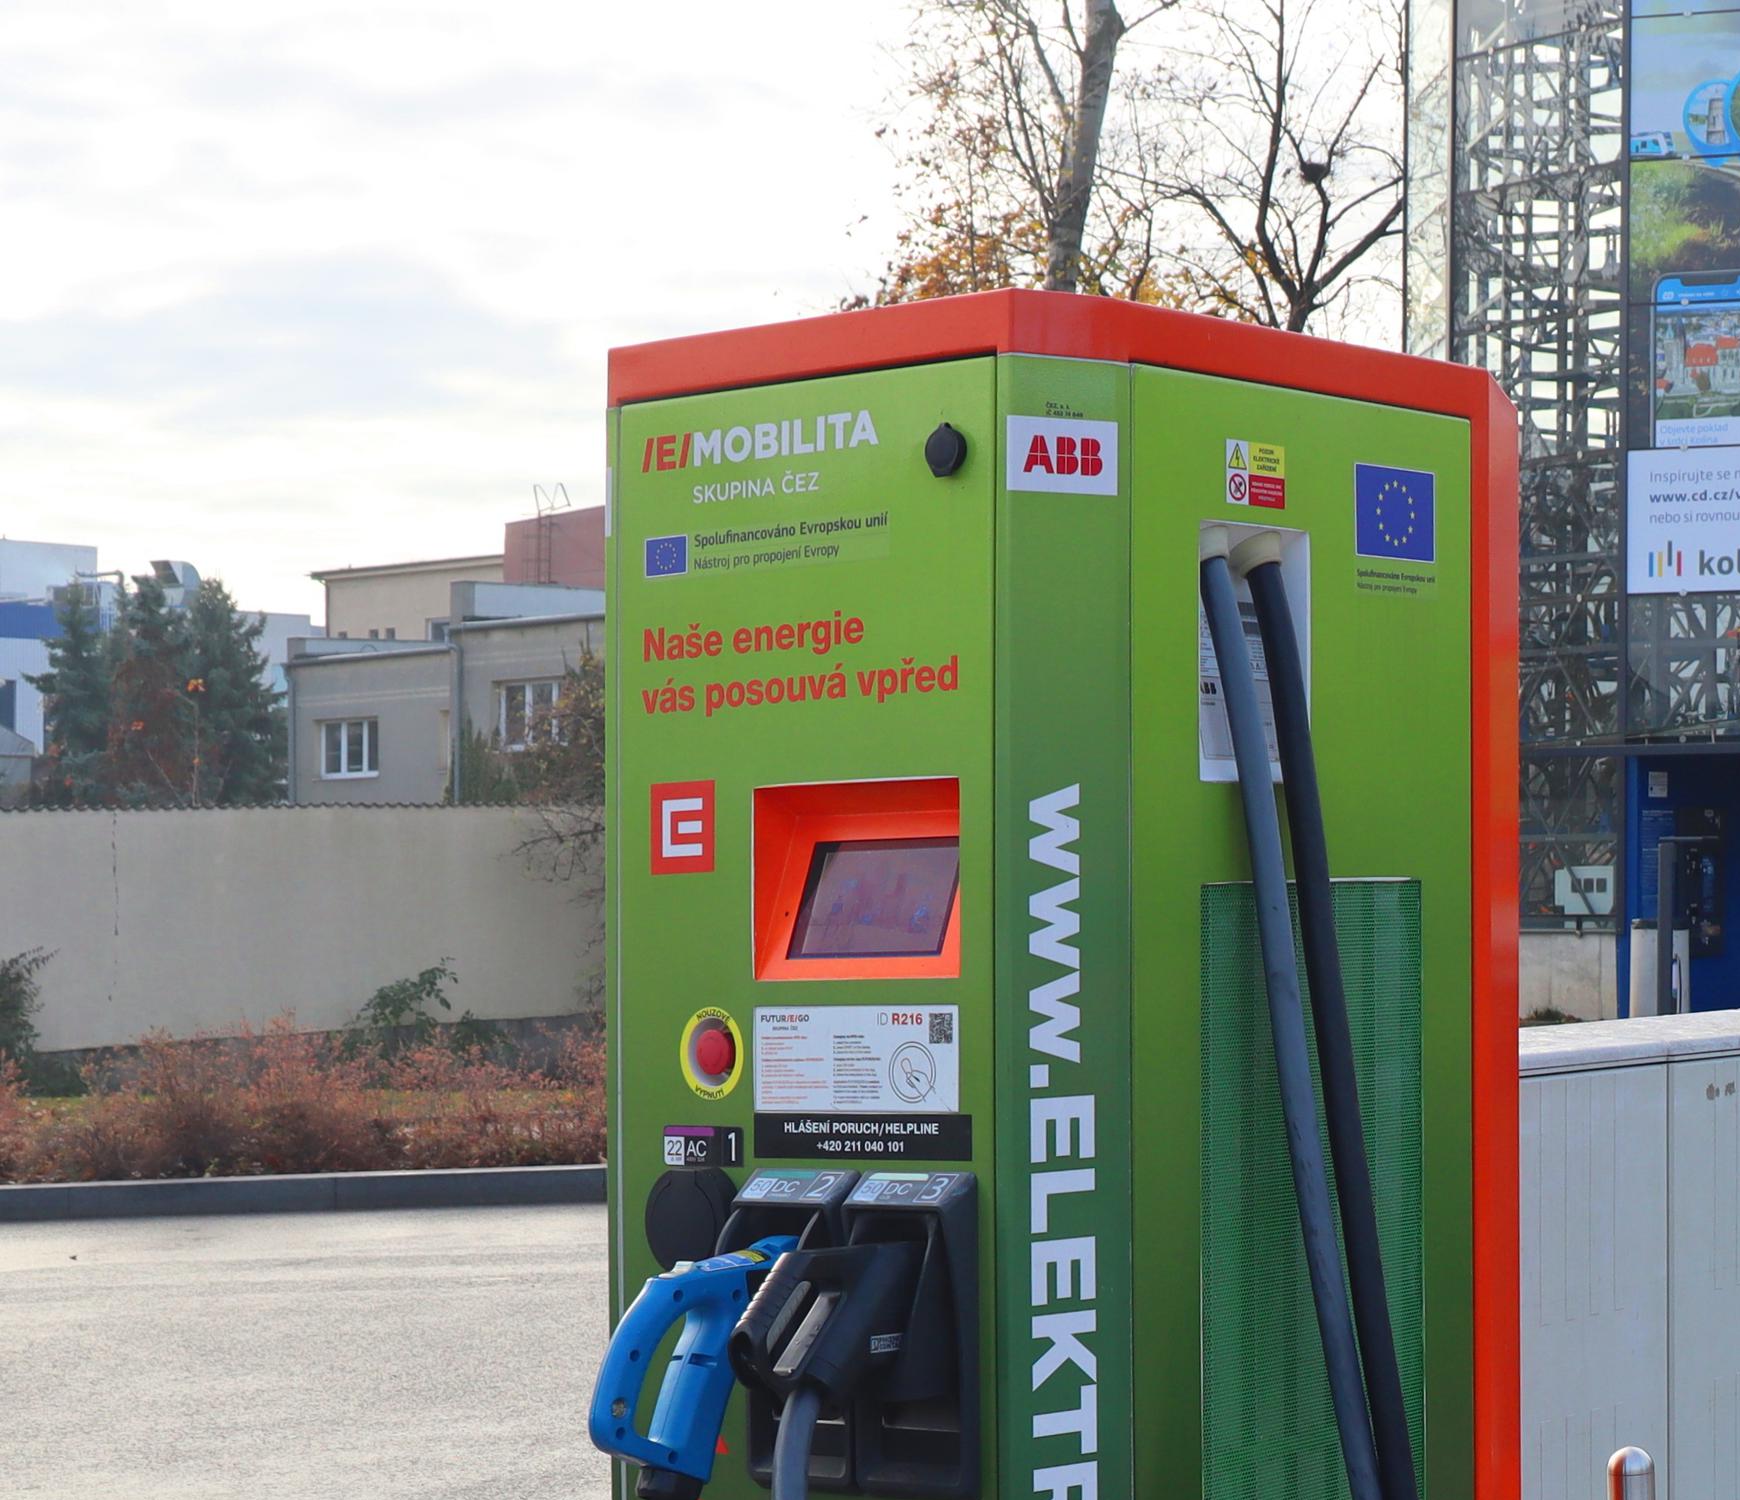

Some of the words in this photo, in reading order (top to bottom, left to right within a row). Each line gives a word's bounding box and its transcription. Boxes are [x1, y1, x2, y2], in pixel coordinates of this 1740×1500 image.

[1023, 434, 1103, 476] ABB
[693, 477, 775, 504] SKUPINA
[782, 470, 819, 494] ČEZ
[1650, 470, 1713, 485] Inspirujte
[1717, 470, 1731, 480] se
[694, 524, 796, 548] Spolufinancováno
[800, 516, 861, 536] Evropskou
[865, 511, 889, 528] unií
[1650, 511, 1681, 524] nebo
[1684, 511, 1693, 523] si
[1696, 510, 1740, 522] rovnou
[694, 555, 730, 572] Nástroj
[733, 554, 750, 569] pro
[753, 546, 801, 567] propojení
[804, 544, 839, 558] Evropy
[643, 624, 722, 662] Naše
[733, 610, 864, 654] energie
[642, 678, 695, 714] vás
[705, 662, 847, 717] posouvá
[857, 655, 959, 703] vpřed
[877, 1012, 888, 1025] ID
[892, 1013, 923, 1026] R216
[784, 1119, 831, 1134] HLÁŠENÍ
[833, 1121, 939, 1137] PORUCH/HELPLINE
[667, 1140, 682, 1156] 22
[686, 1140, 707, 1157] AC
[728, 1132, 736, 1162] 1
[816, 1140, 842, 1152] +420
[845, 1141, 861, 1152] 211
[864, 1141, 883, 1152] 040
[888, 1141, 904, 1153] 101
[750, 1180, 770, 1192] 50
[771, 1180, 800, 1193] DC
[805, 1175, 835, 1197] 2
[861, 1182, 884, 1194] 50
[883, 1182, 912, 1195] DC
[921, 1177, 949, 1200] 3
